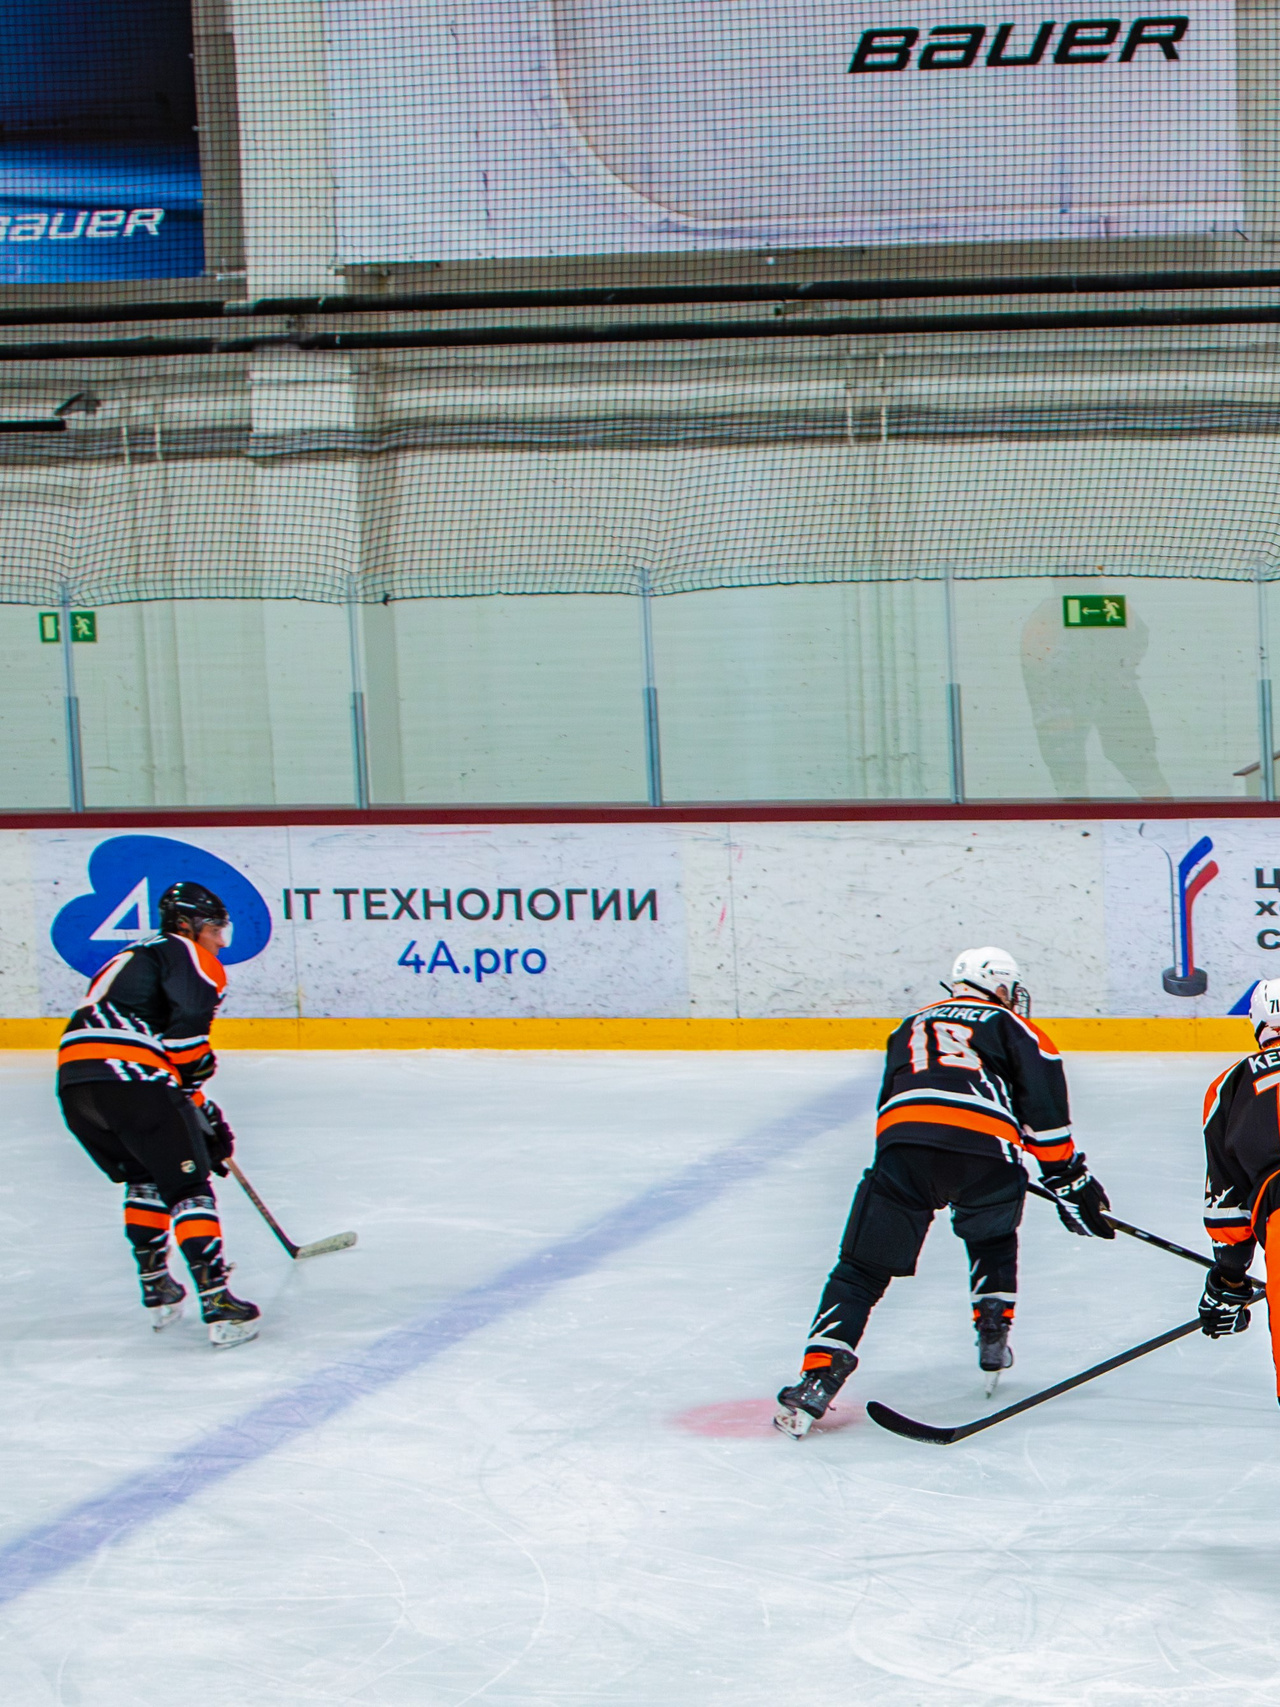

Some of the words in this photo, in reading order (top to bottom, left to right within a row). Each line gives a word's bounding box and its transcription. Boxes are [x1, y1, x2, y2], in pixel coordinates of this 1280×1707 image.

[847, 15, 1189, 73] BAUER
[283, 888, 320, 920] IT
[333, 887, 659, 921] ТЕХНОЛОГИИ
[398, 939, 547, 983] 4A.pro
[1269, 998, 1280, 1014] 71
